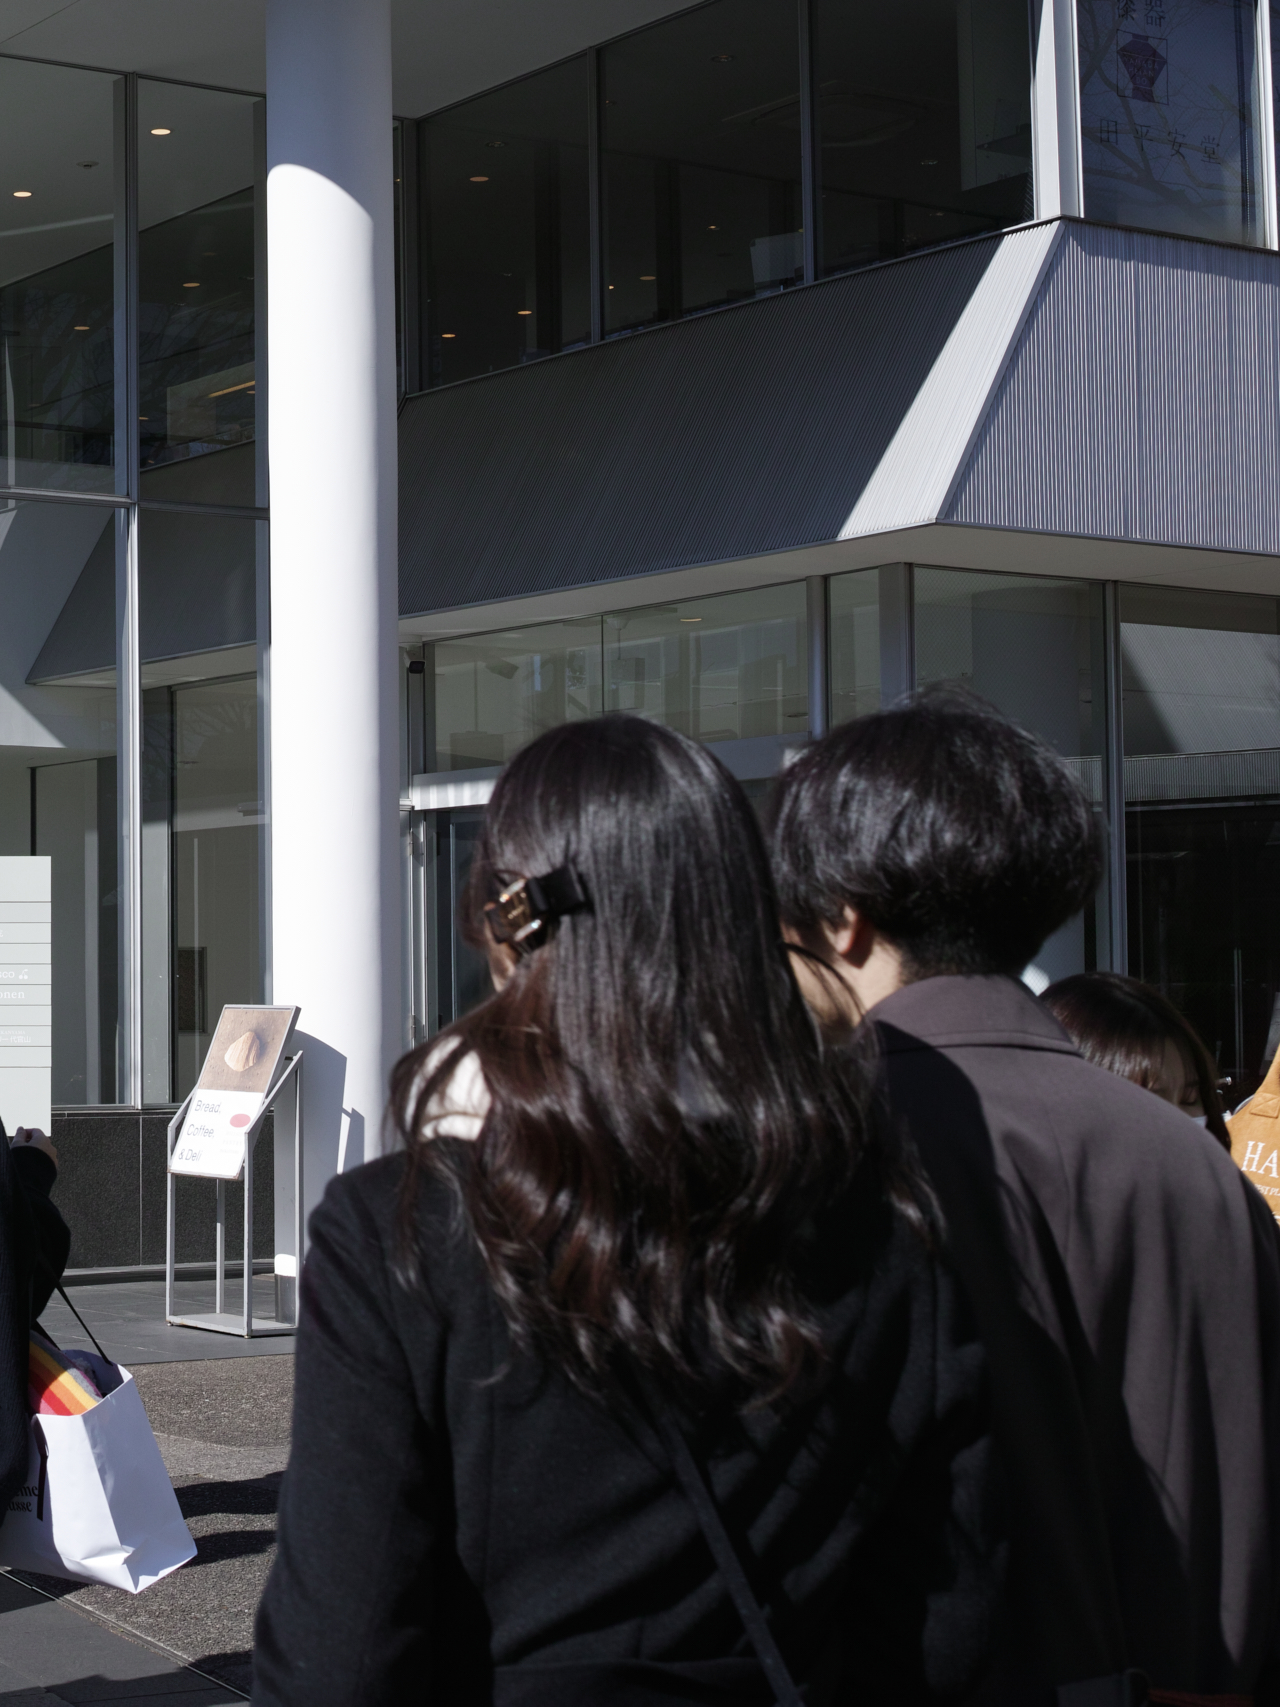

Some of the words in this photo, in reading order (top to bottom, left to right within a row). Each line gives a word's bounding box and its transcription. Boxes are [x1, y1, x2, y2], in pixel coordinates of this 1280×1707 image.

[1100, 119, 1221, 165] 田平安堂
[178, 1148, 185, 1160] &
[185, 1149, 203, 1162] Deli
[7, 1501, 32, 1513] usse
